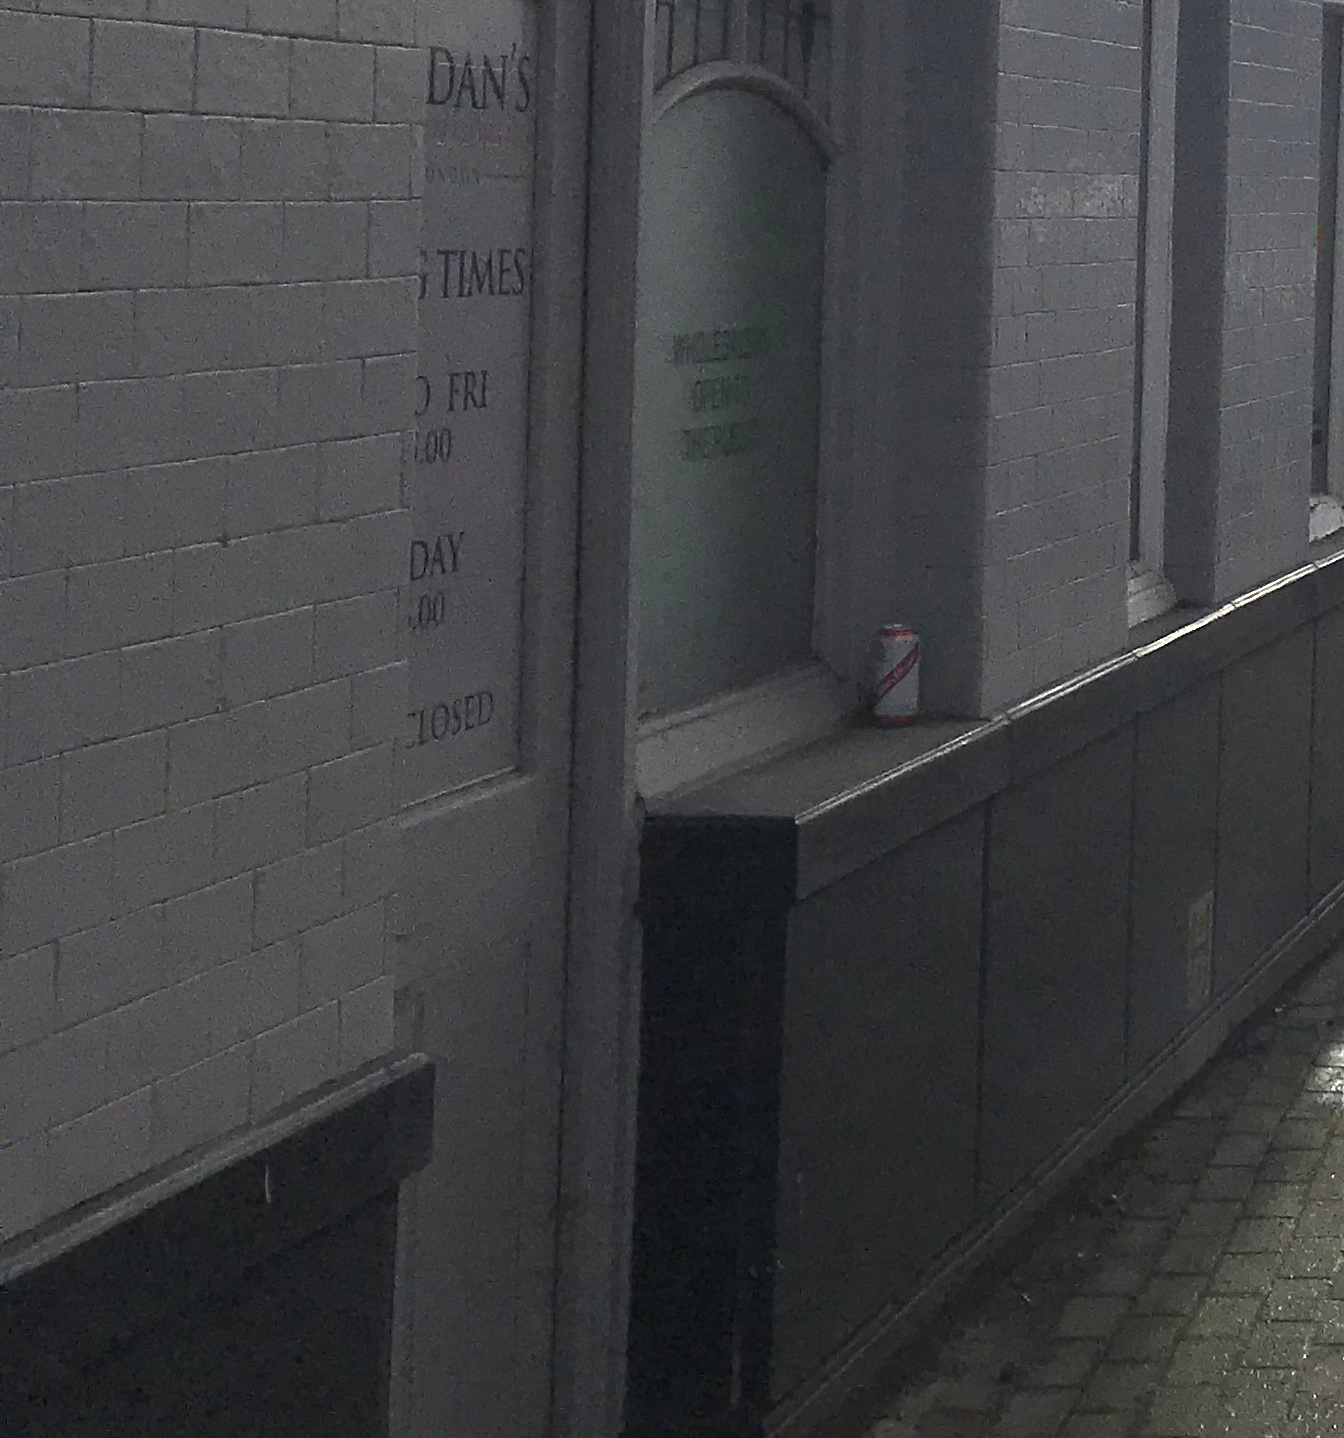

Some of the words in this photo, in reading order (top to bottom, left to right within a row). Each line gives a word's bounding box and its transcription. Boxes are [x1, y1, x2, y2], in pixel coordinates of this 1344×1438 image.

[426, 42, 531, 113] DAN'S
[436, 247, 527, 300] TIMES
[446, 369, 489, 413] FRI
[410, 530, 465, 583] DAY
